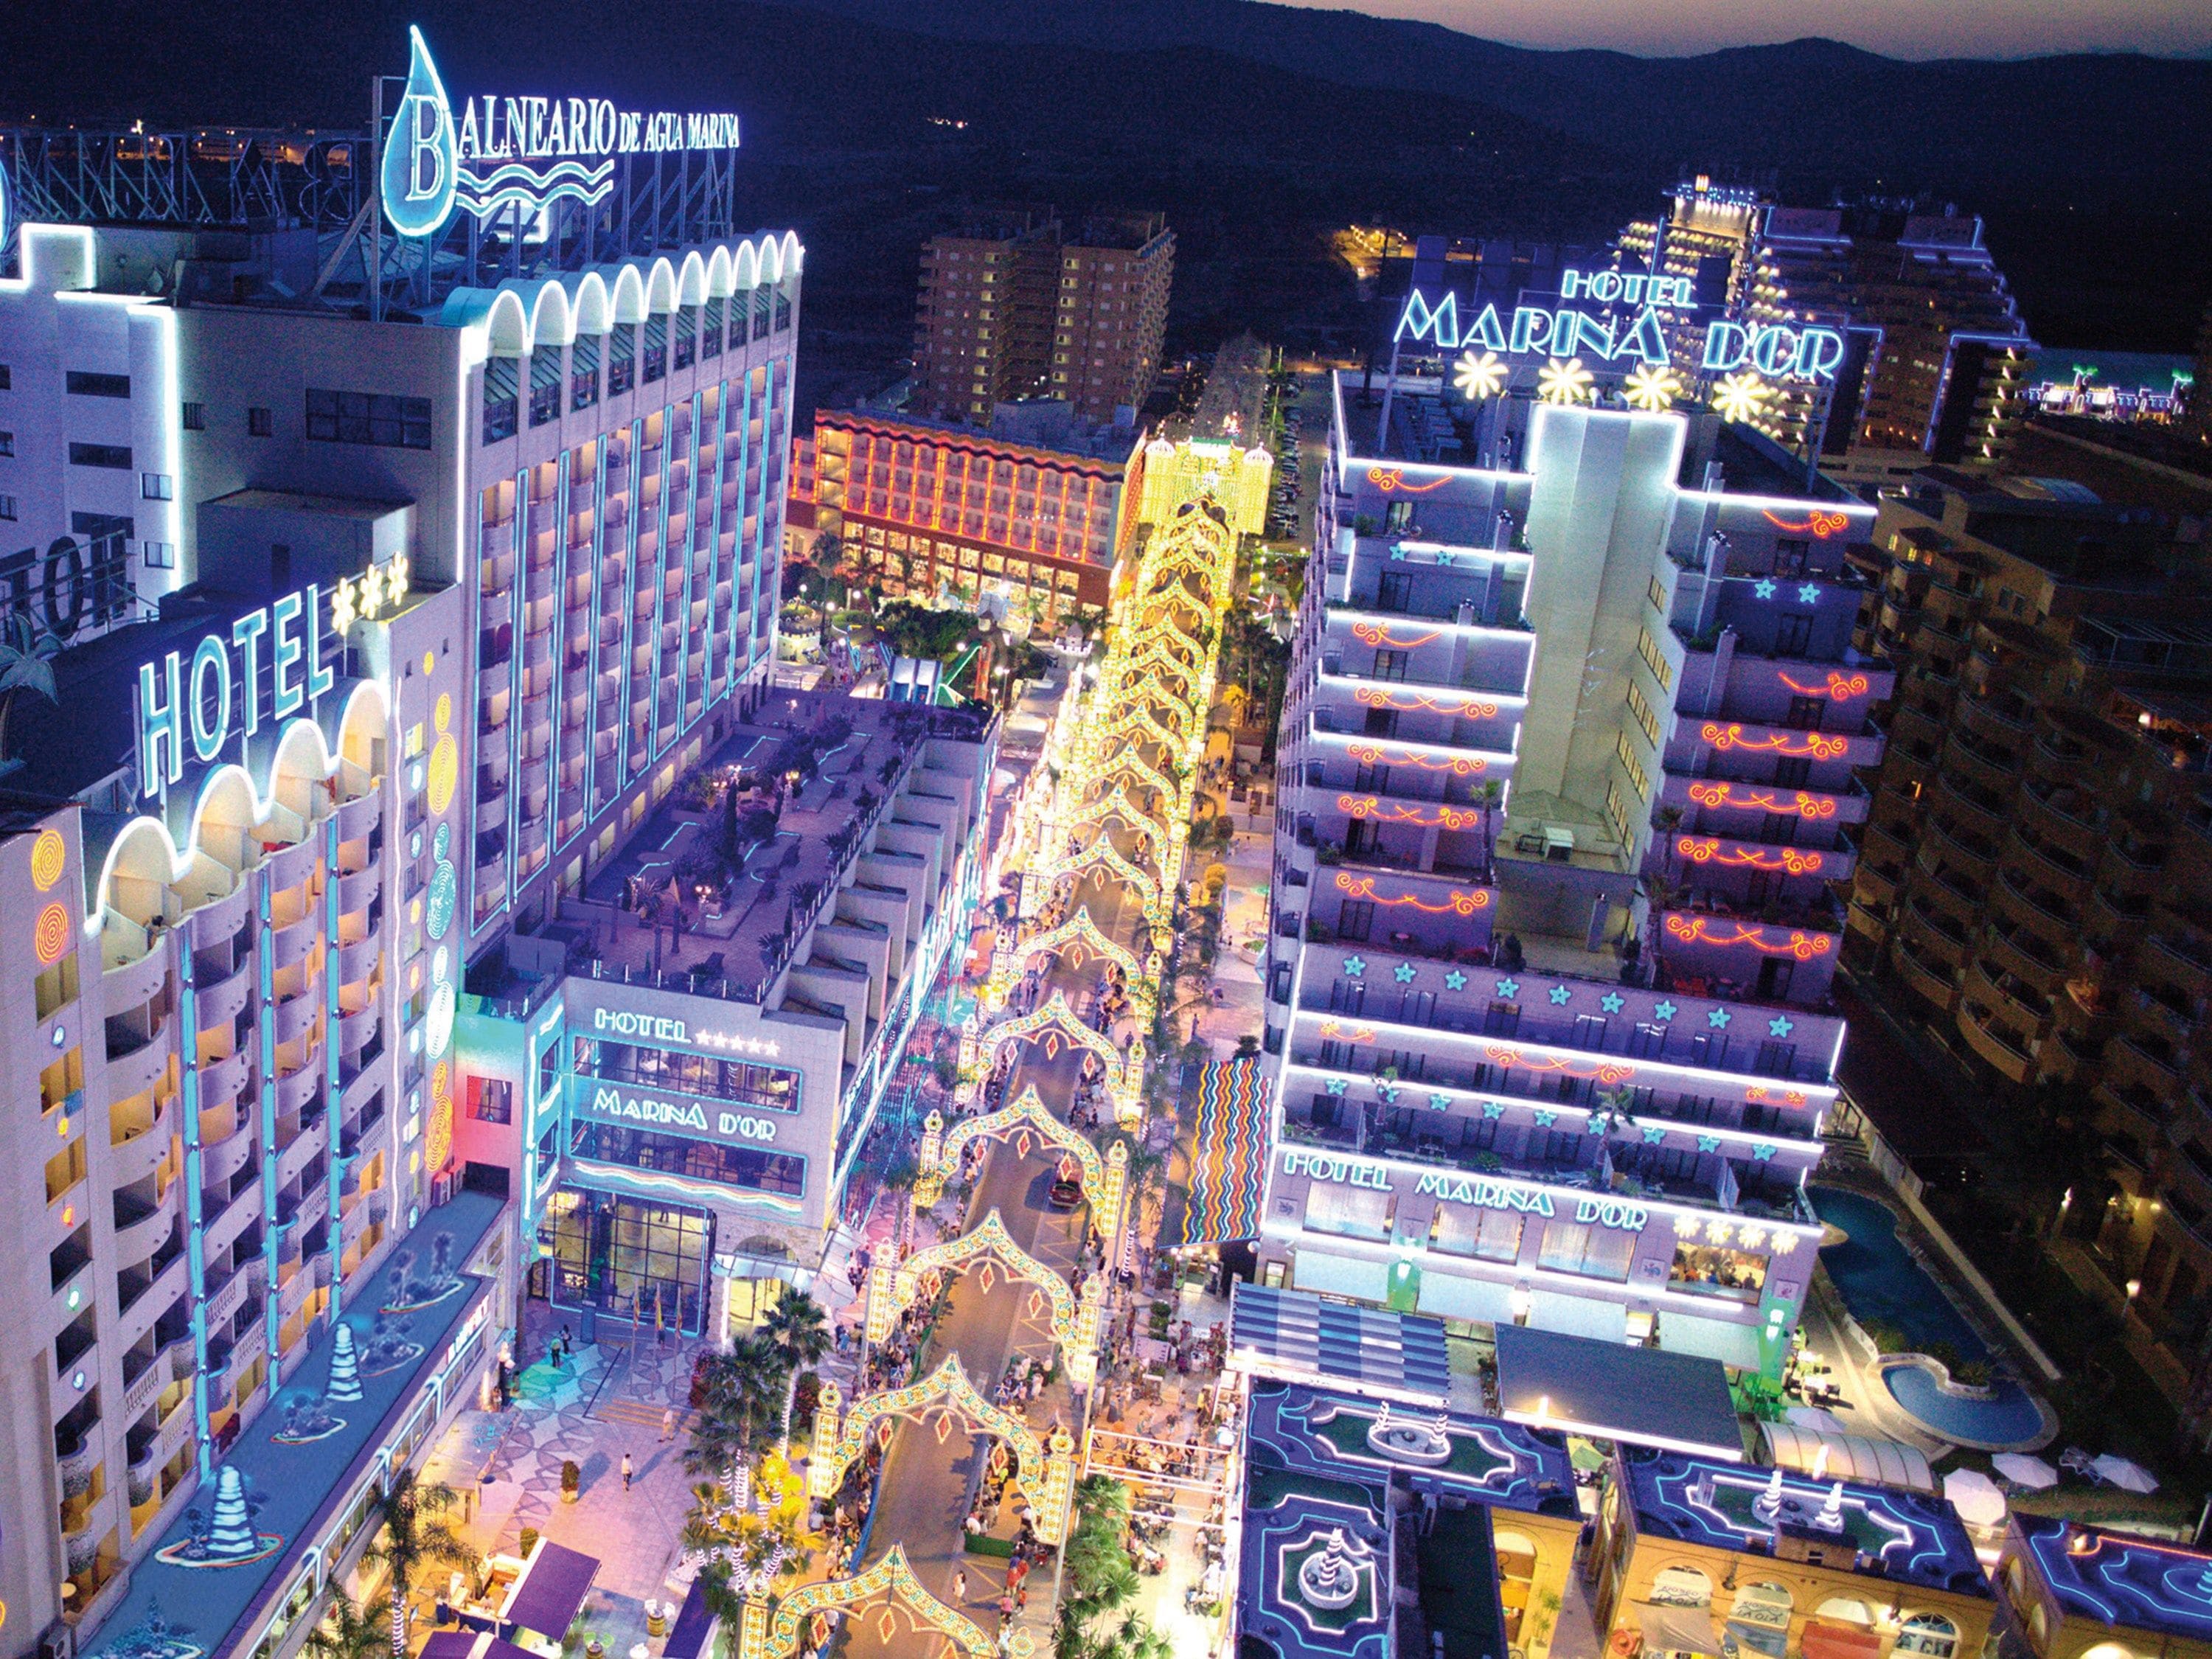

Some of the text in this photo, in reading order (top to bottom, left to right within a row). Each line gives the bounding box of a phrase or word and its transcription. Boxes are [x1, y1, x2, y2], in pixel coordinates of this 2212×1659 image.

[618, 112, 641, 153] DE
[644, 113, 684, 152] AGUA
[686, 112, 740, 149] MARINA
[1561, 269, 1698, 309] HOTEL
[1394, 288, 1844, 379] MARINA D'OR
[139, 582, 334, 799] HOTEL
[594, 1007, 693, 1045] HOTEL
[593, 1088, 776, 1142] MARINA D'OR
[1284, 1152, 1649, 1232] HOTEL MARINA D'OR
